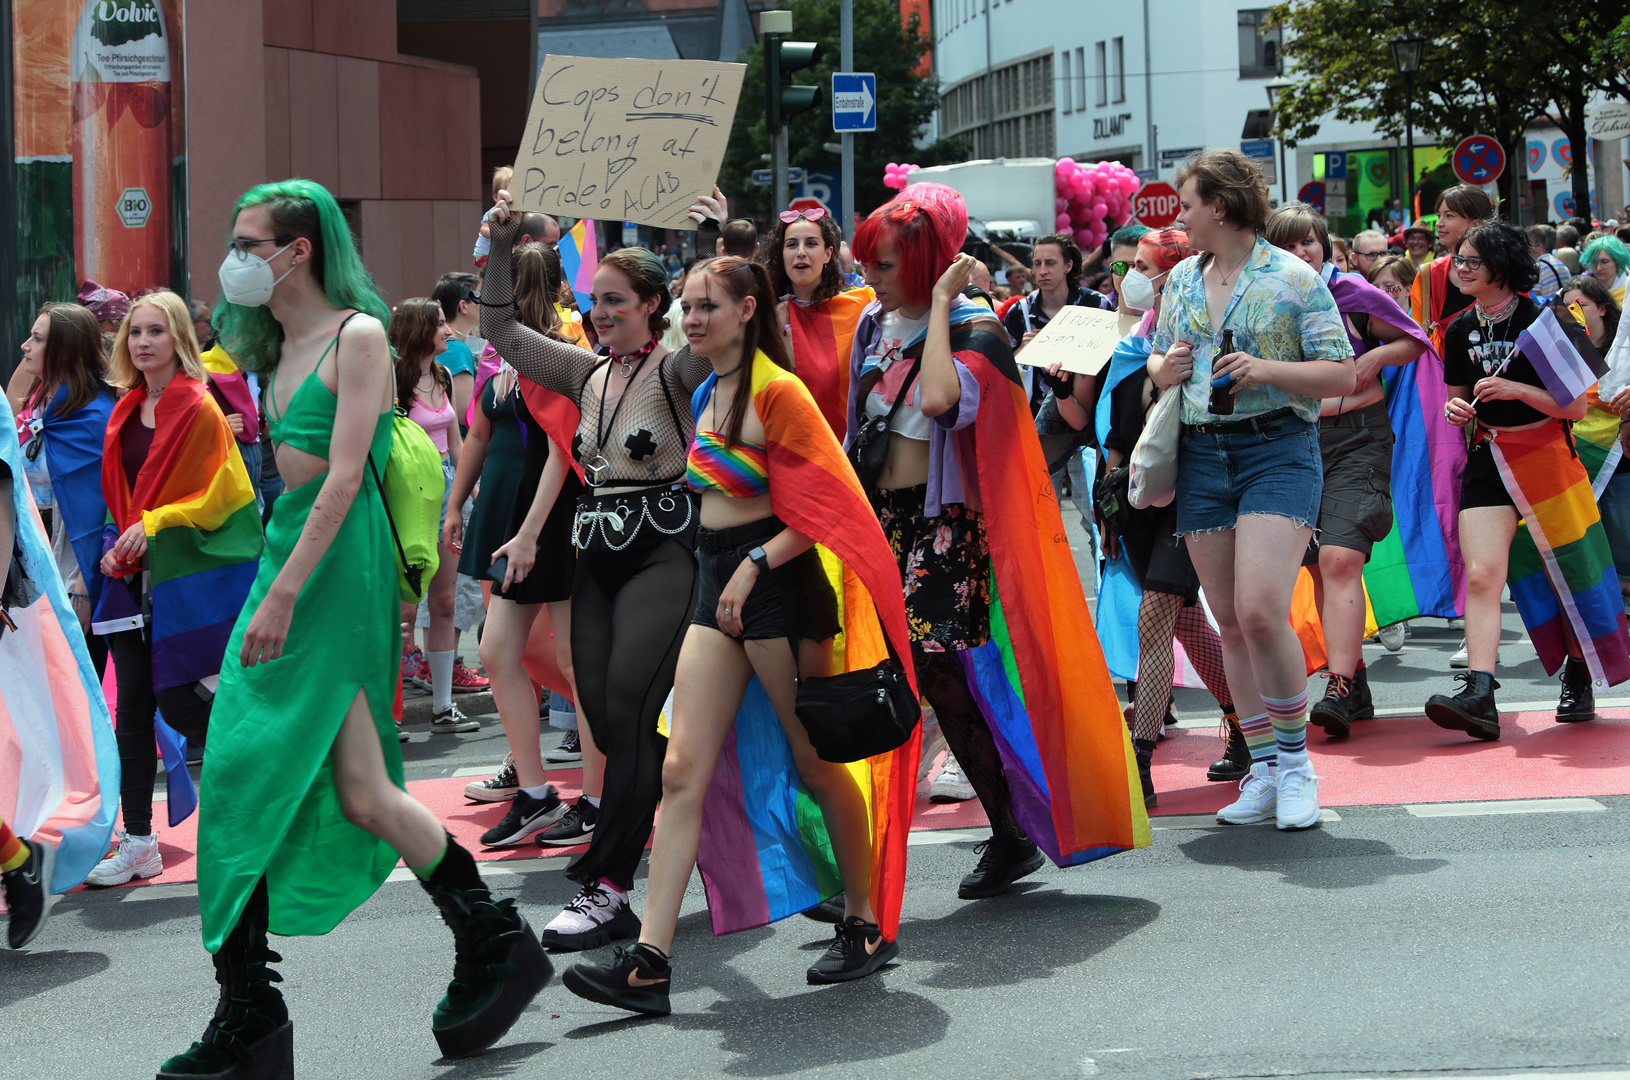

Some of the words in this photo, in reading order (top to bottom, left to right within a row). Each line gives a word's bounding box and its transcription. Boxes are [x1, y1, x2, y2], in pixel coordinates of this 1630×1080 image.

[98, 0, 158, 22] Volvic
[96, 54, 110, 62] Tee
[542, 64, 620, 122] Cops
[632, 69, 726, 110] don't
[836, 96, 864, 108] Einbahnstraße
[531, 111, 640, 158] belong
[662, 127, 700, 159] at
[1329, 154, 1342, 176] P
[624, 171, 680, 219] ACAB
[1137, 194, 1179, 217] STOP
[1058, 310, 1072, 326] I
[1070, 311, 1103, 328] have
[1105, 321, 1118, 331] a
